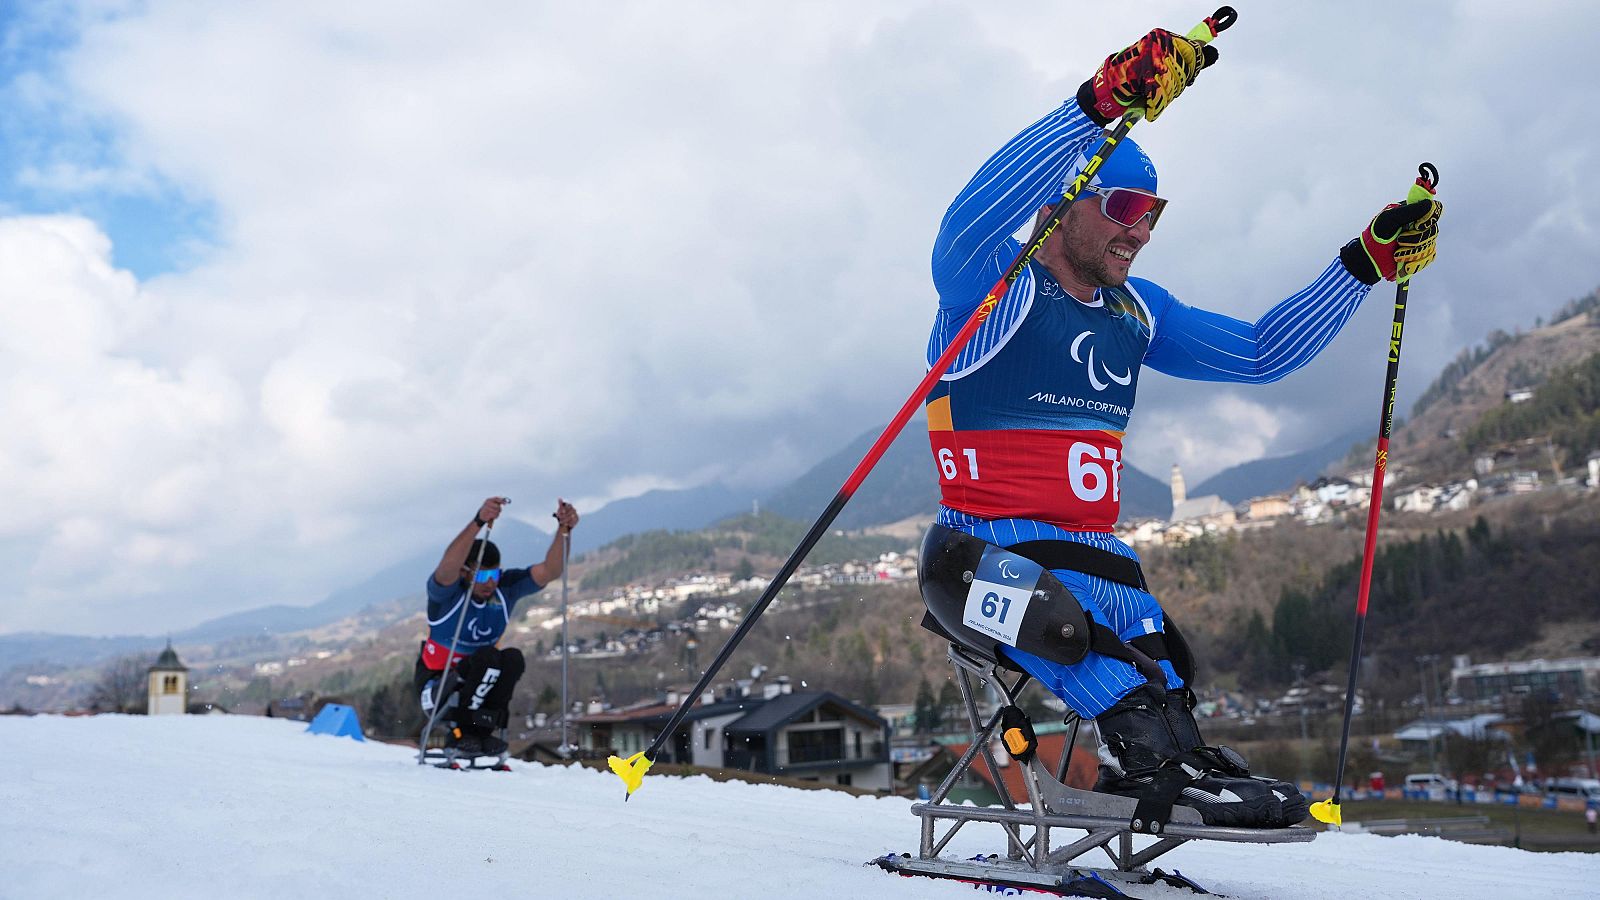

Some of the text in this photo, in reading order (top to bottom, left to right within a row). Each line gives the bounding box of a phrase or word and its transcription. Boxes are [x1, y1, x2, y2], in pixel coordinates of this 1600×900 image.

[1028, 392, 1085, 408] MILANO
[1086, 400, 1128, 417] CORTINA
[938, 447, 979, 480] 61
[1068, 441, 1120, 502] 61
[981, 591, 1012, 624] 61
